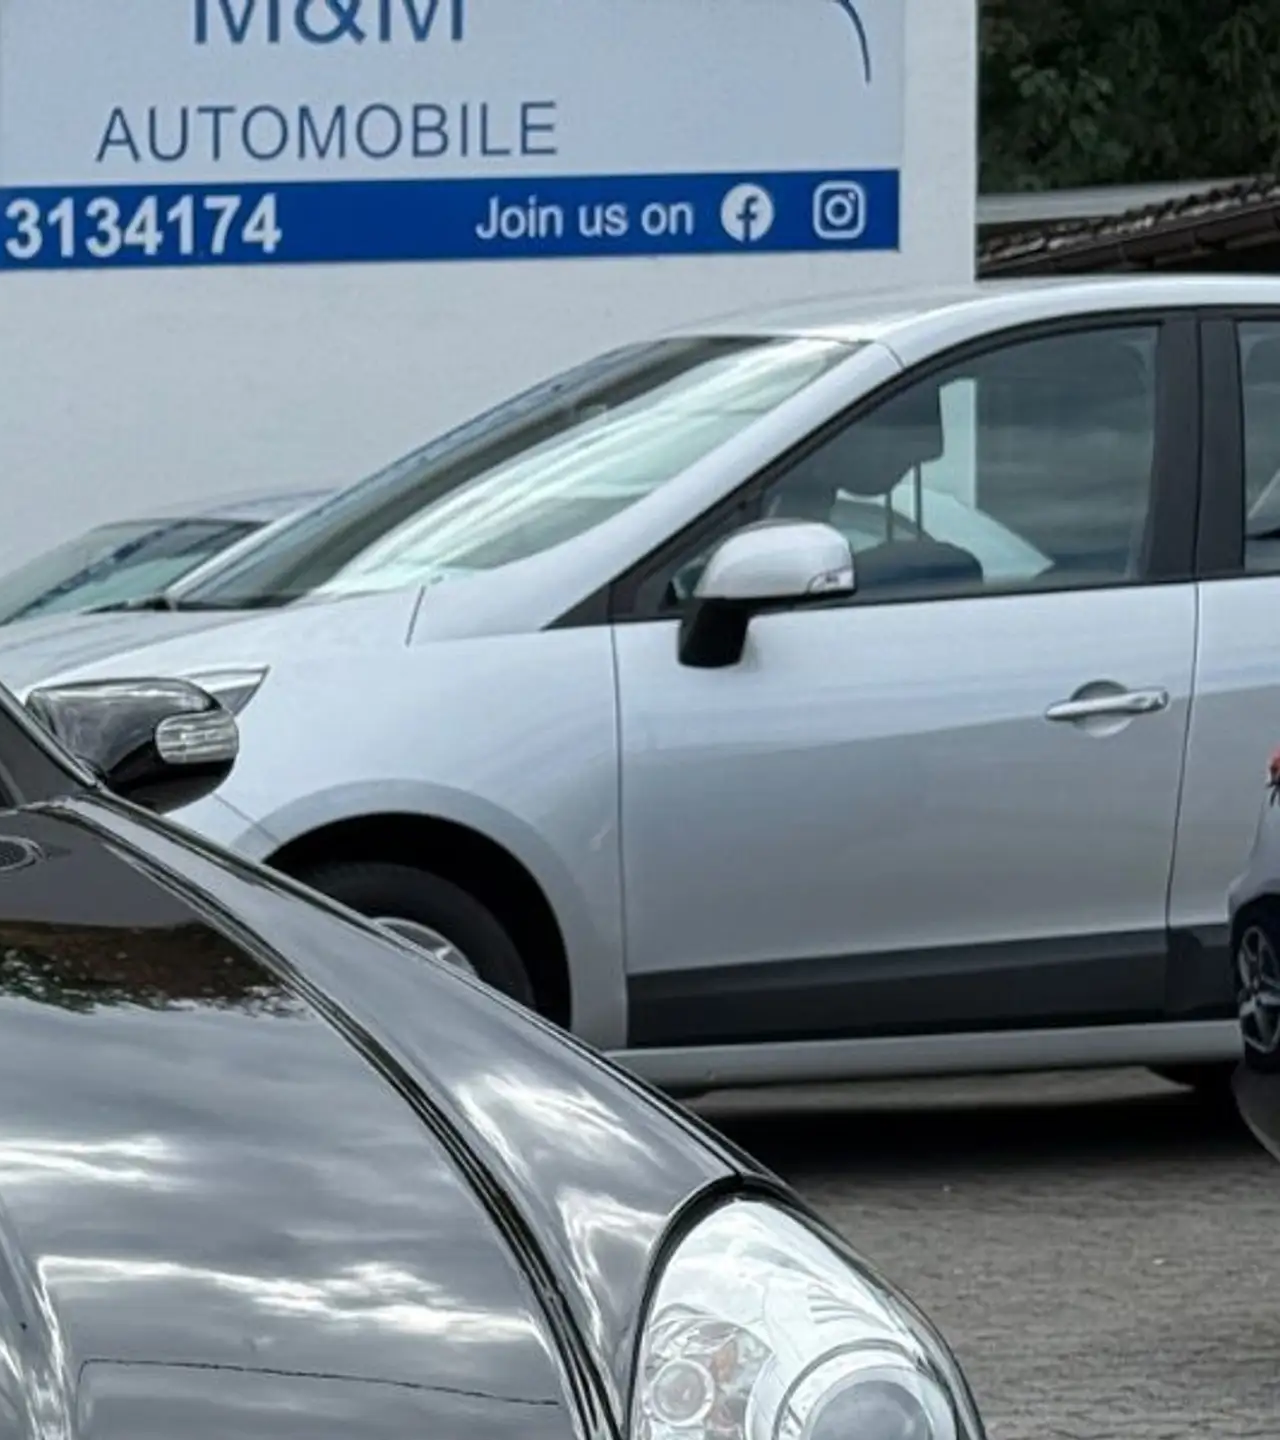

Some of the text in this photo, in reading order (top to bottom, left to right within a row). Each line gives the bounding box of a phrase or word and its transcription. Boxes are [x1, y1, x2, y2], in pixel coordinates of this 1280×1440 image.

[95, 100, 557, 163] AUTOMOBILE
[5, 193, 282, 258] 3134174
[476, 195, 694, 239] Join us on
